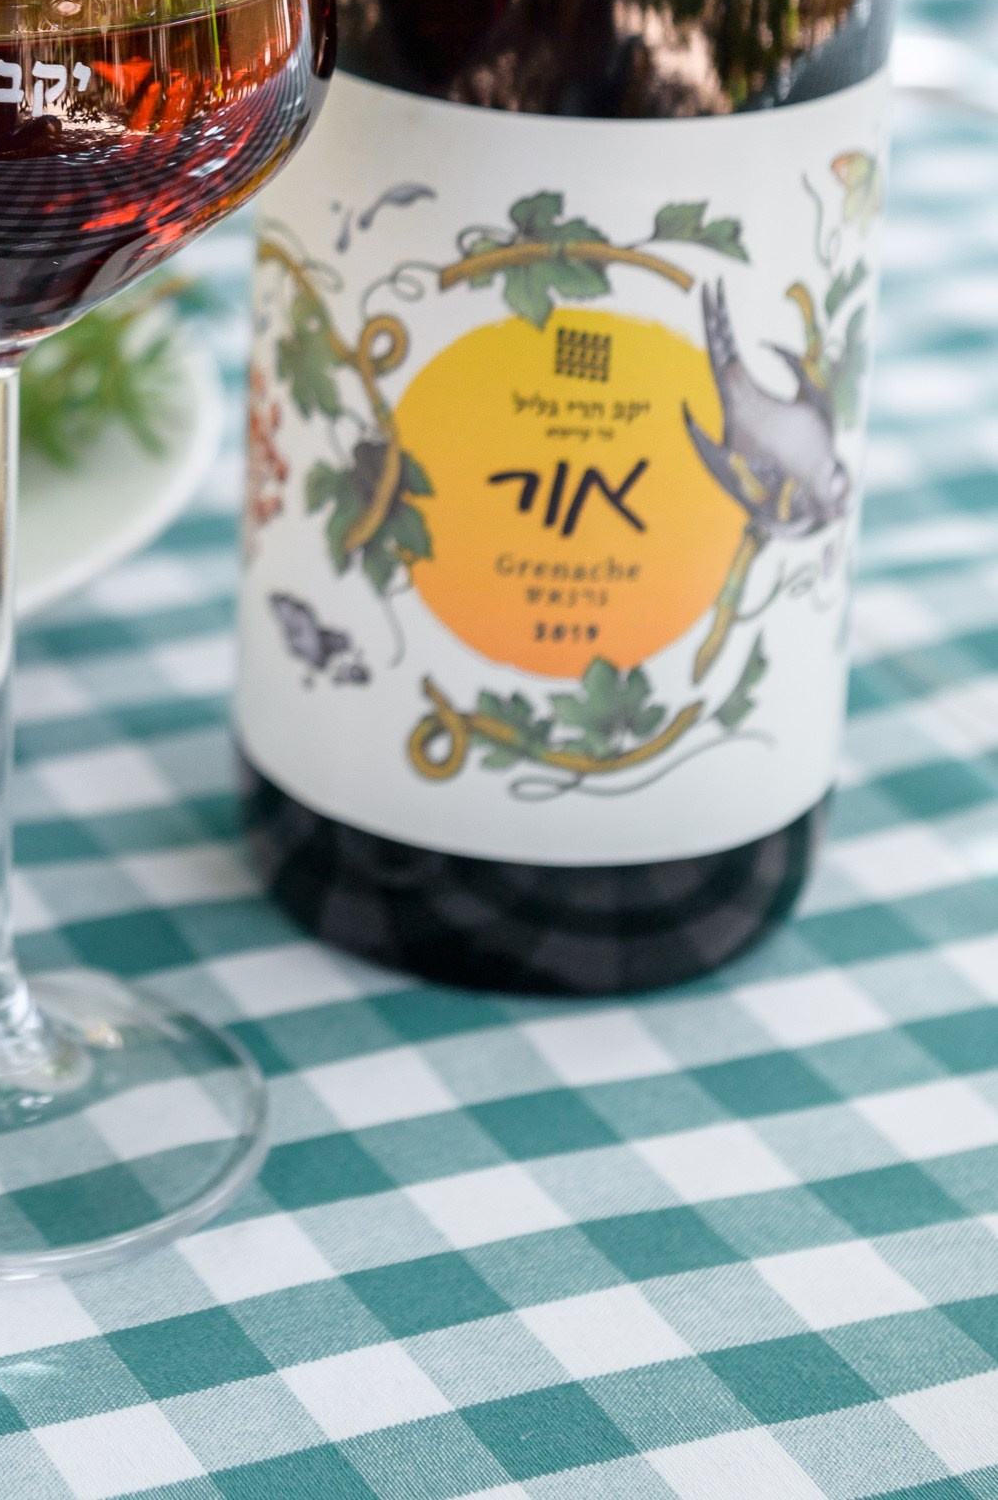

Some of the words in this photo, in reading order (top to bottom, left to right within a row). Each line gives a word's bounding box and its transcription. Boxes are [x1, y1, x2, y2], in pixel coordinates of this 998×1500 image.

[612, 399, 651, 424] יקב
[487, 457, 649, 538] אור
[495, 551, 642, 582] Grenache
[534, 620, 600, 643] 2019
